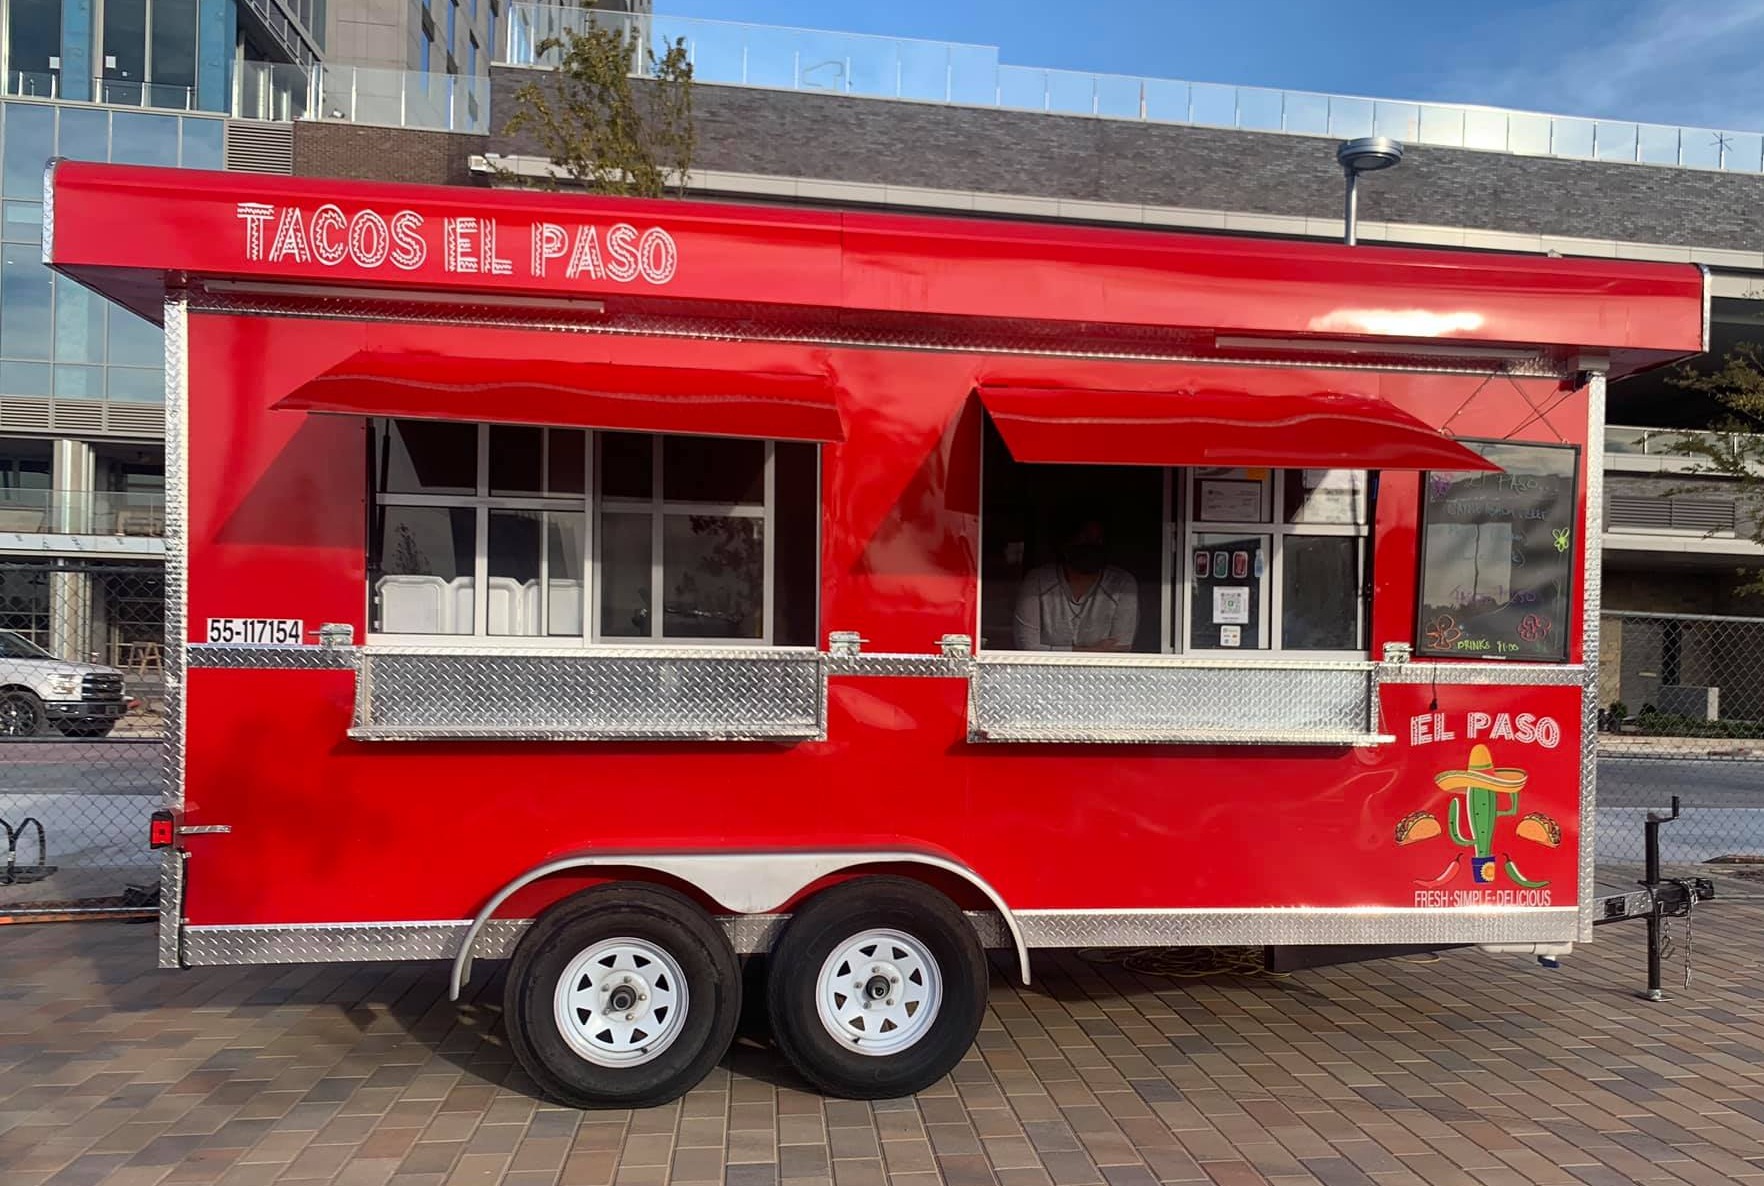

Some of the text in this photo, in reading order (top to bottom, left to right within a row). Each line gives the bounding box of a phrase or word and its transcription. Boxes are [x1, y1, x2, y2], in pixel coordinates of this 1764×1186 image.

[237, 202, 678, 285] TACOS EL PASO
[210, 620, 300, 643] 55-117154
[1457, 639, 1490, 650] DRINKS
[1410, 712, 1560, 748] EL PASO
[1414, 890, 1448, 907] FRESH
[1497, 889, 1551, 906] DELICIOUS
